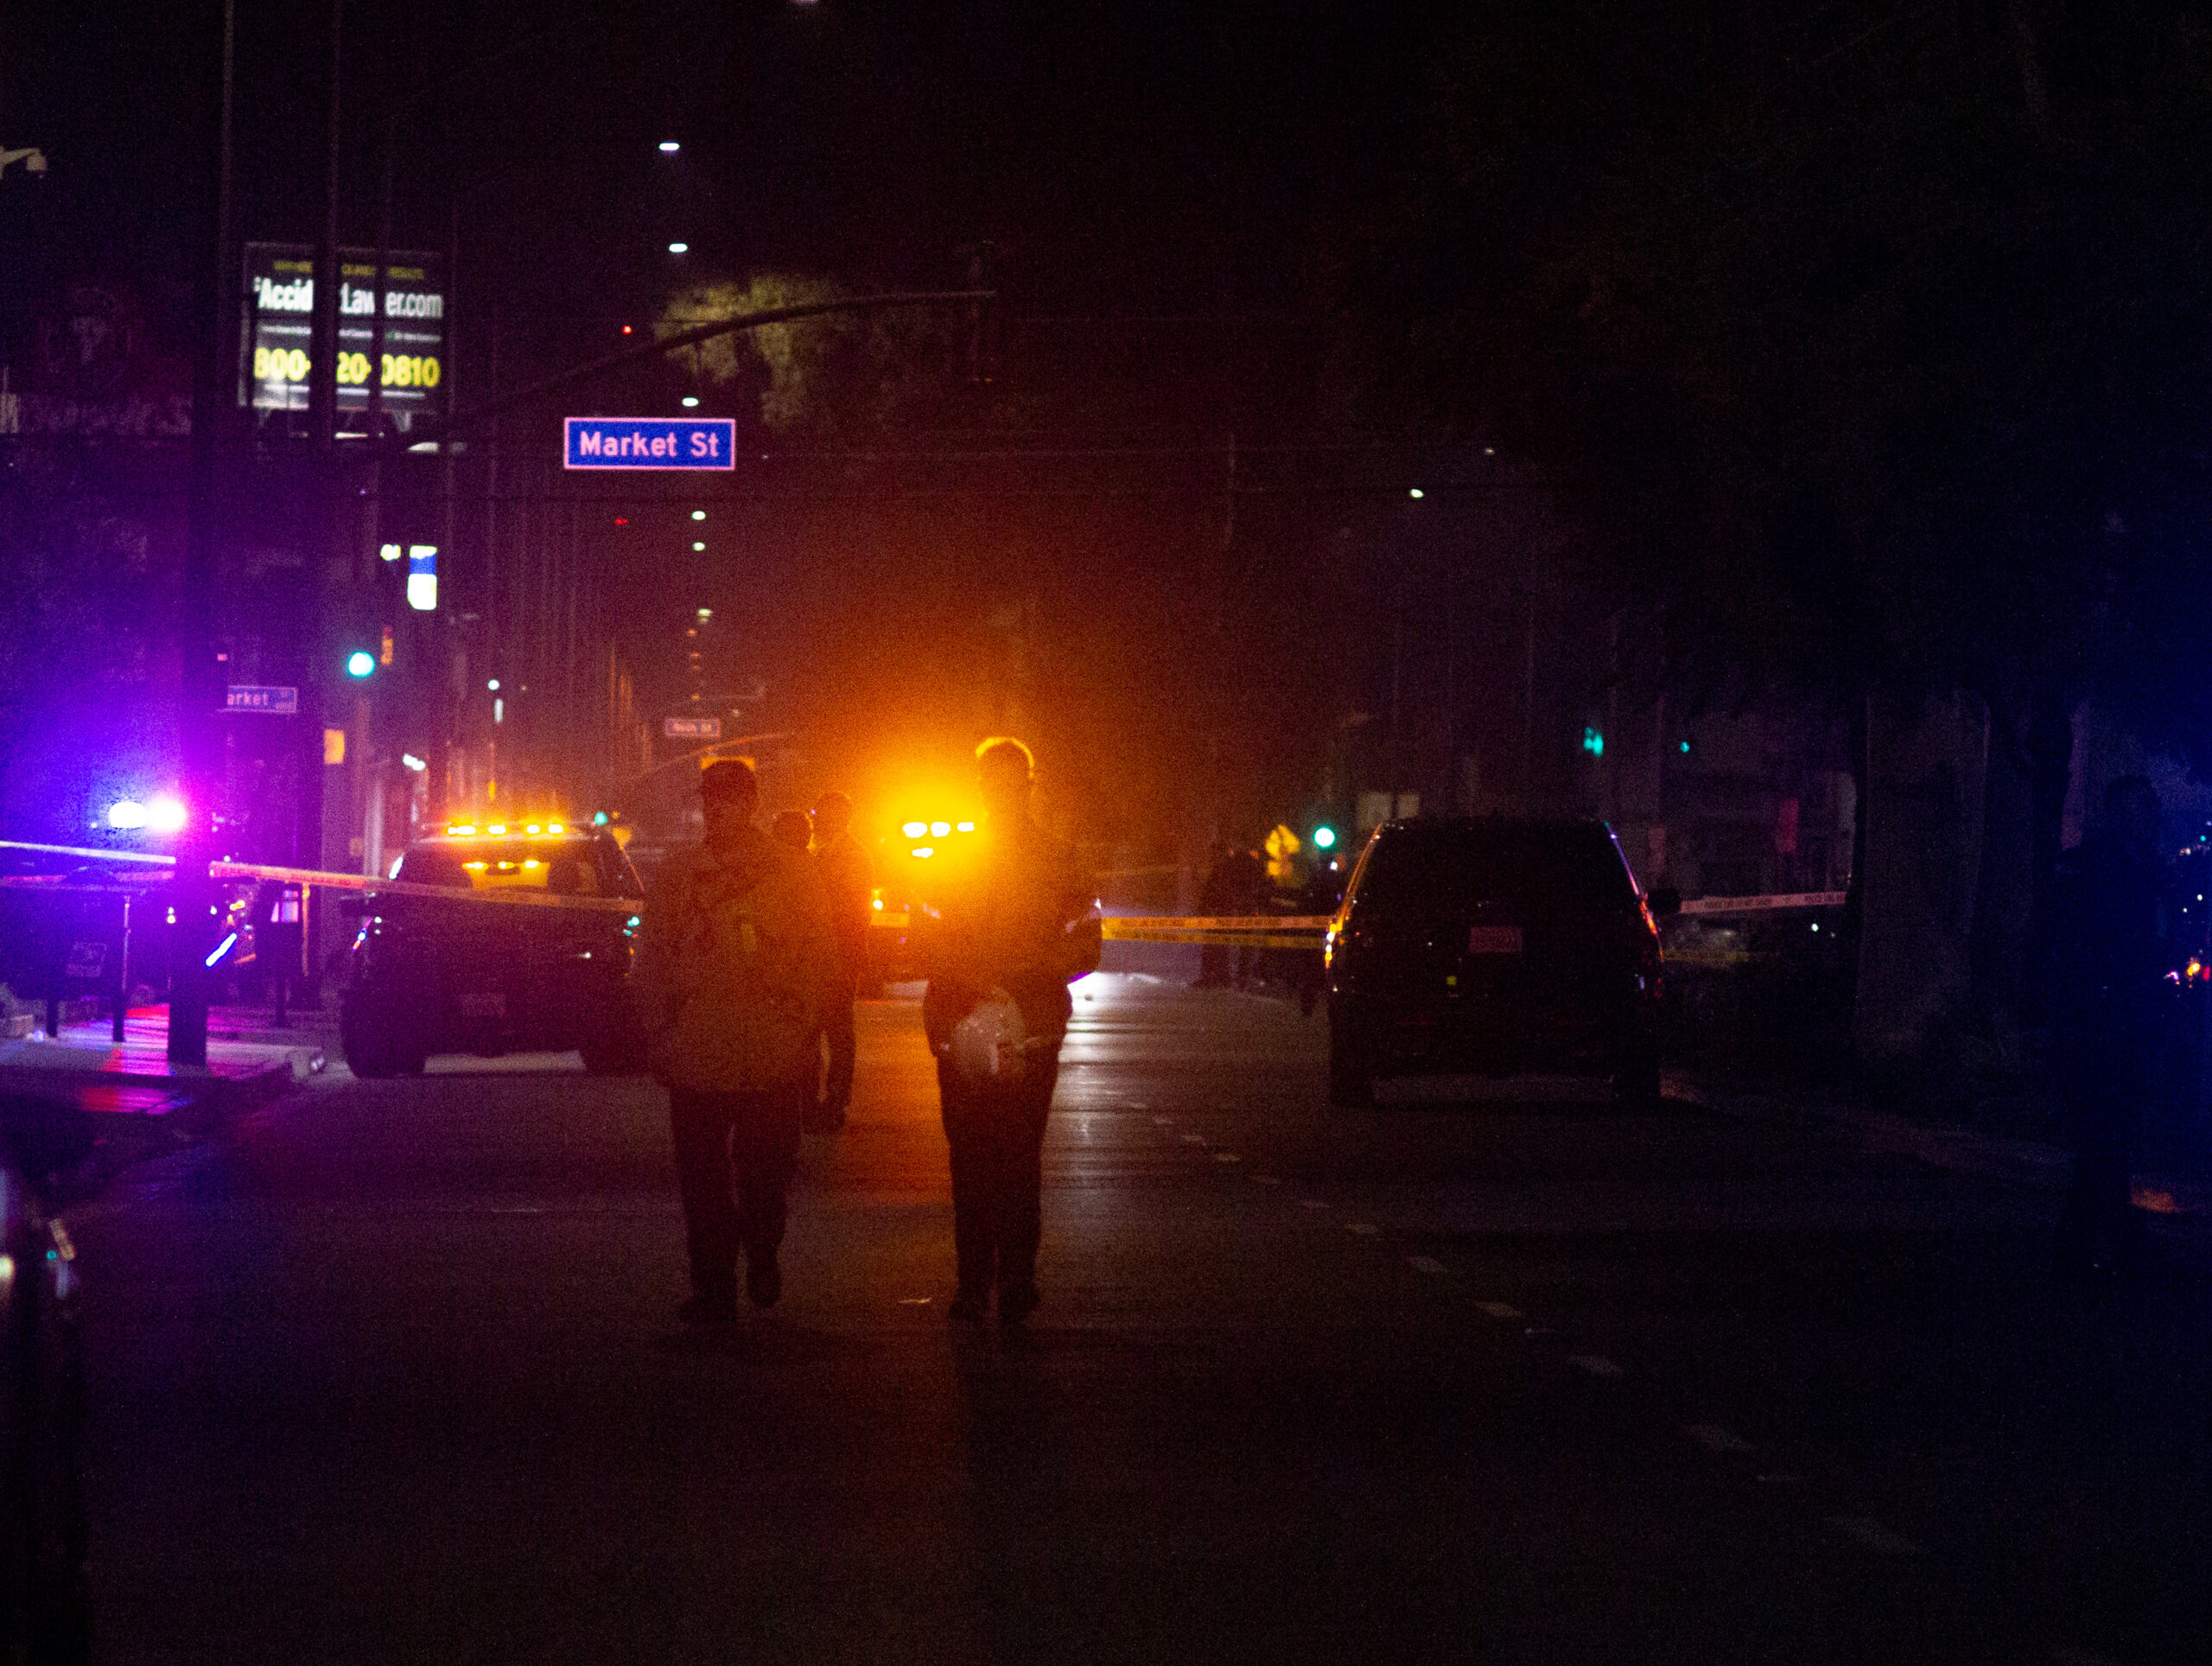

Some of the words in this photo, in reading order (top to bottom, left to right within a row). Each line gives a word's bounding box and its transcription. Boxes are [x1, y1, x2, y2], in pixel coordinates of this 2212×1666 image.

[258, 277, 443, 318] AccidLawer.com
[254, 347, 442, 387] 800-20-0810
[580, 430, 677, 457] Market
[690, 431, 720, 458] St
[227, 691, 269, 706] arket
